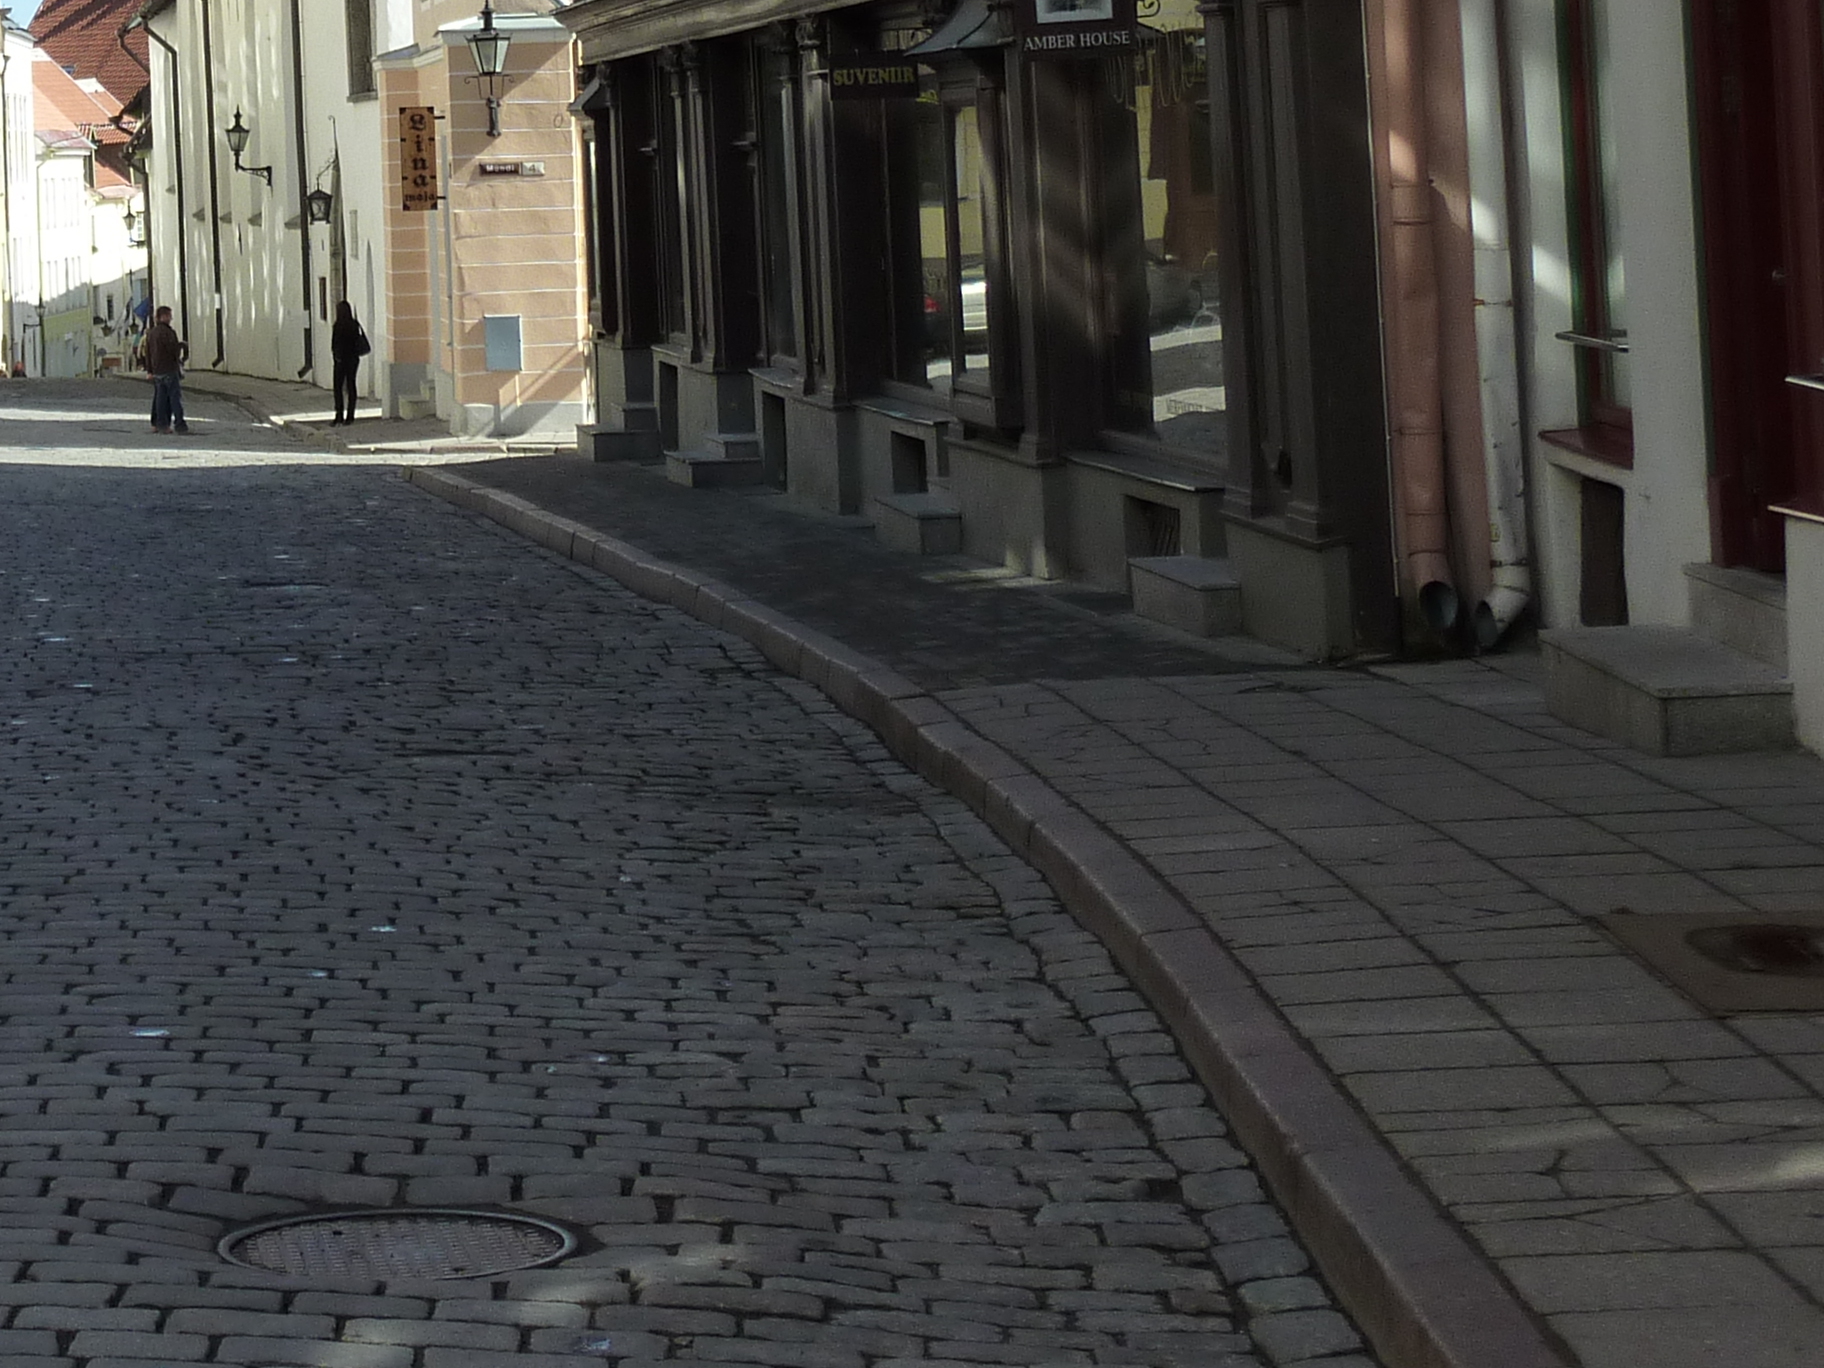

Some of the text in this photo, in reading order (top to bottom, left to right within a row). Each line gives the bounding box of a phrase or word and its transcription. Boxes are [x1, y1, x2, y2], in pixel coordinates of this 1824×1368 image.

[1023, 29, 1131, 51] AMBER HOUSE
[832, 65, 915, 87] SUVENIIR
